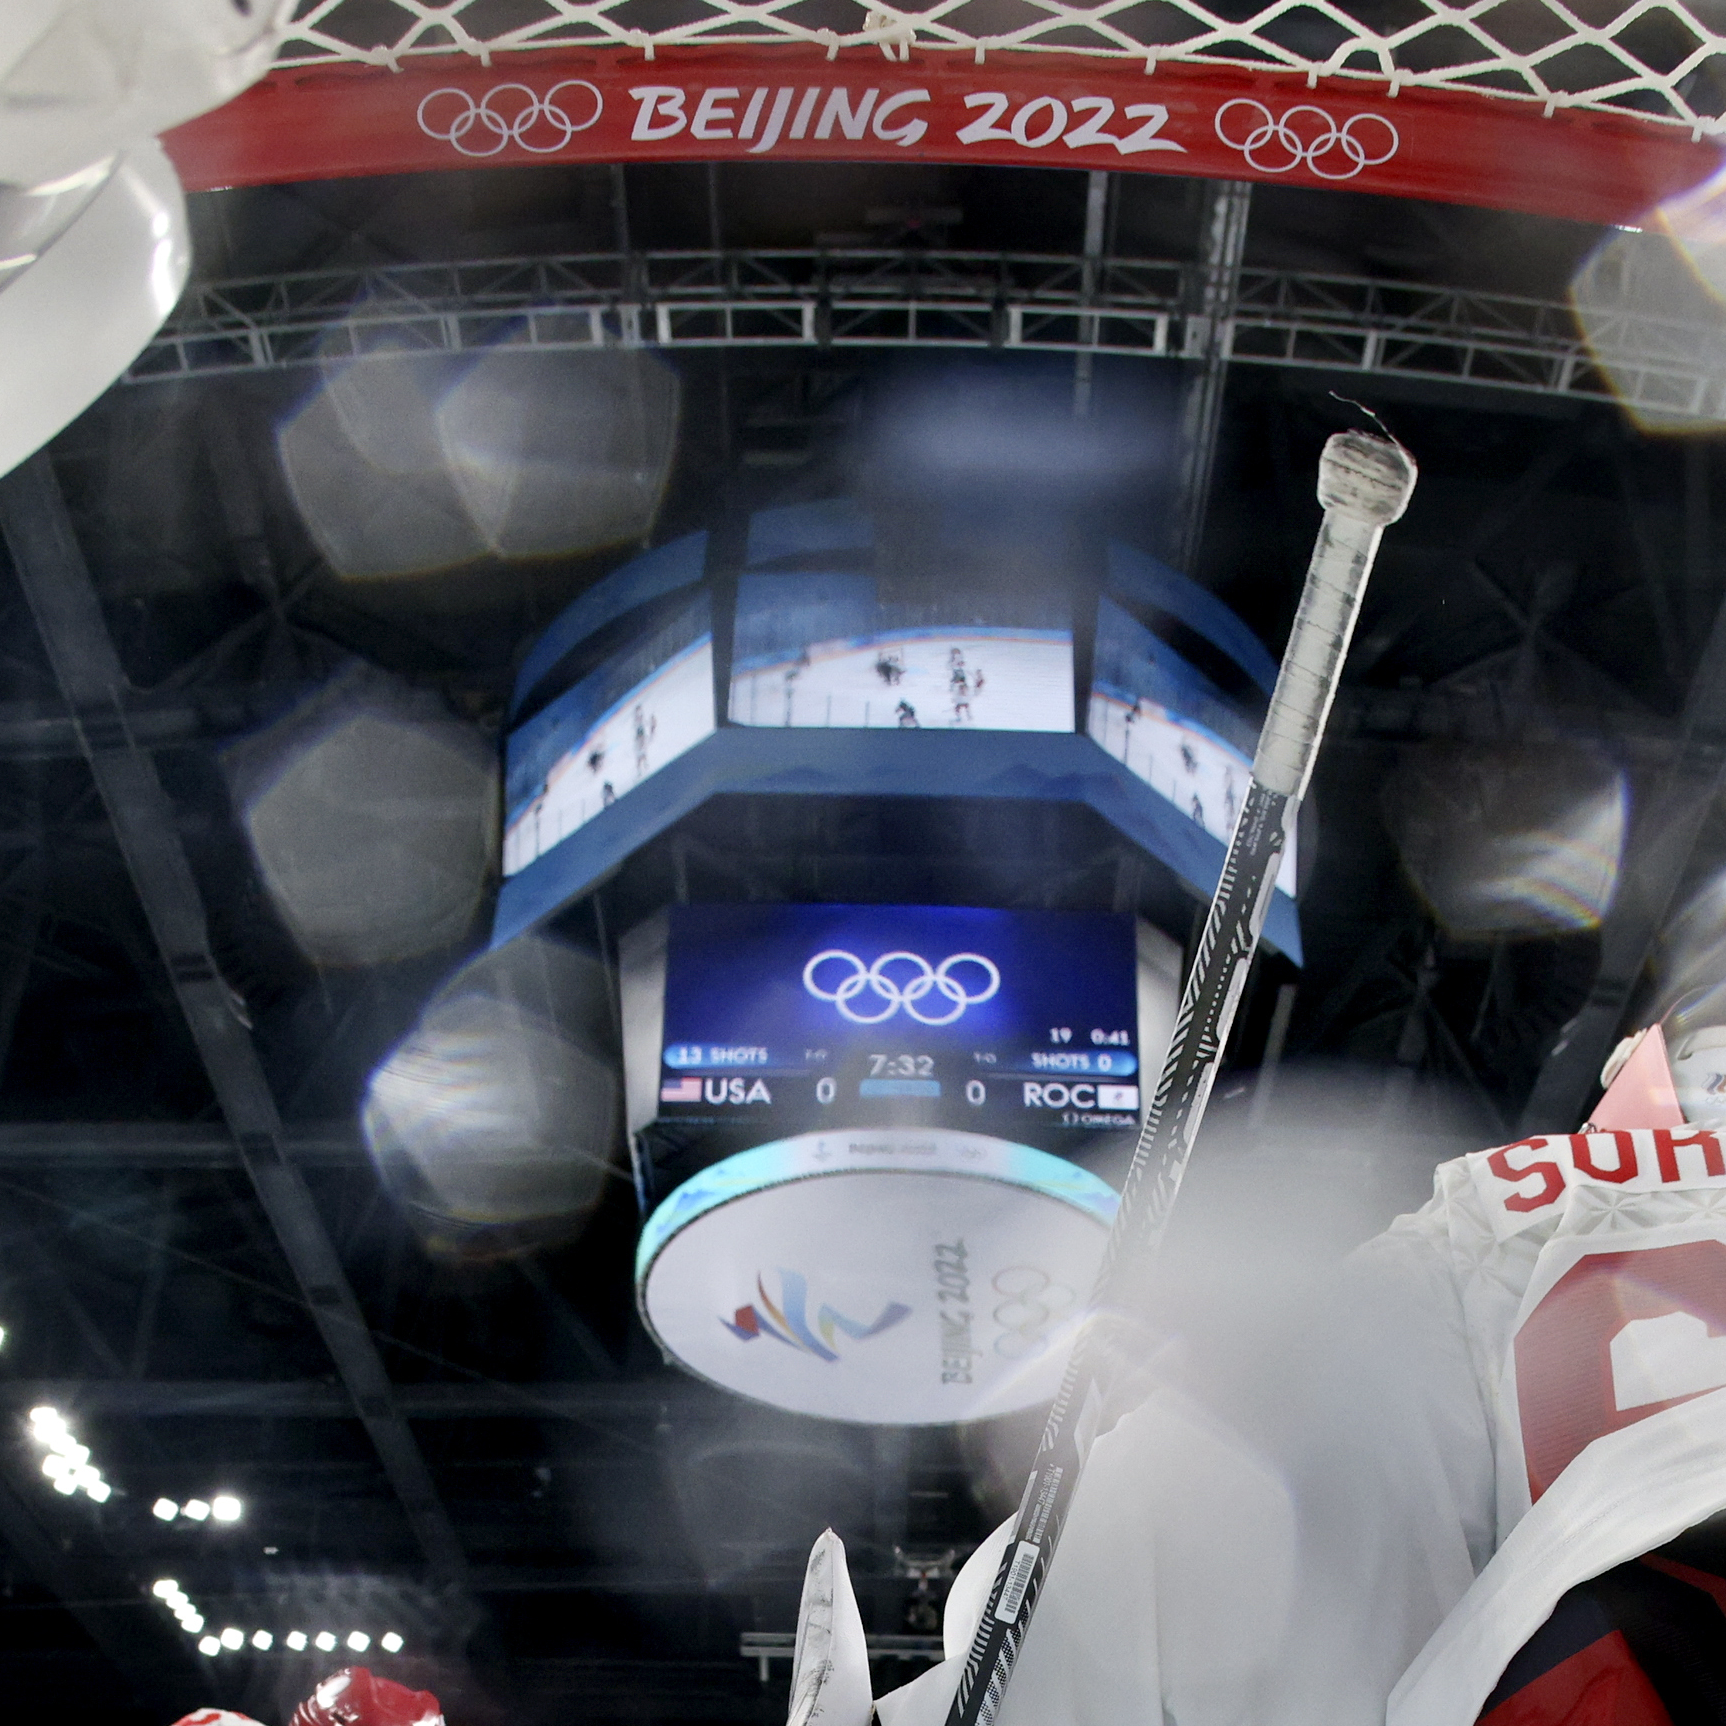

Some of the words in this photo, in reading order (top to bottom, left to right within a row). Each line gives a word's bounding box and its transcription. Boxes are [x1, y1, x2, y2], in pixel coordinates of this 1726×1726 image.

[629, 84, 928, 154] BEIJING
[956, 90, 1186, 153] 2022
[710, 1046, 767, 1065] SHOTS
[868, 1053, 934, 1078] 7:32
[1031, 1051, 1090, 1070] SHOTS
[704, 1077, 772, 1105] USA
[815, 1076, 837, 1105] 0
[965, 1079, 987, 1106] 0
[1023, 1081, 1096, 1109] ROC
[934, 1237, 971, 1302] 2022
